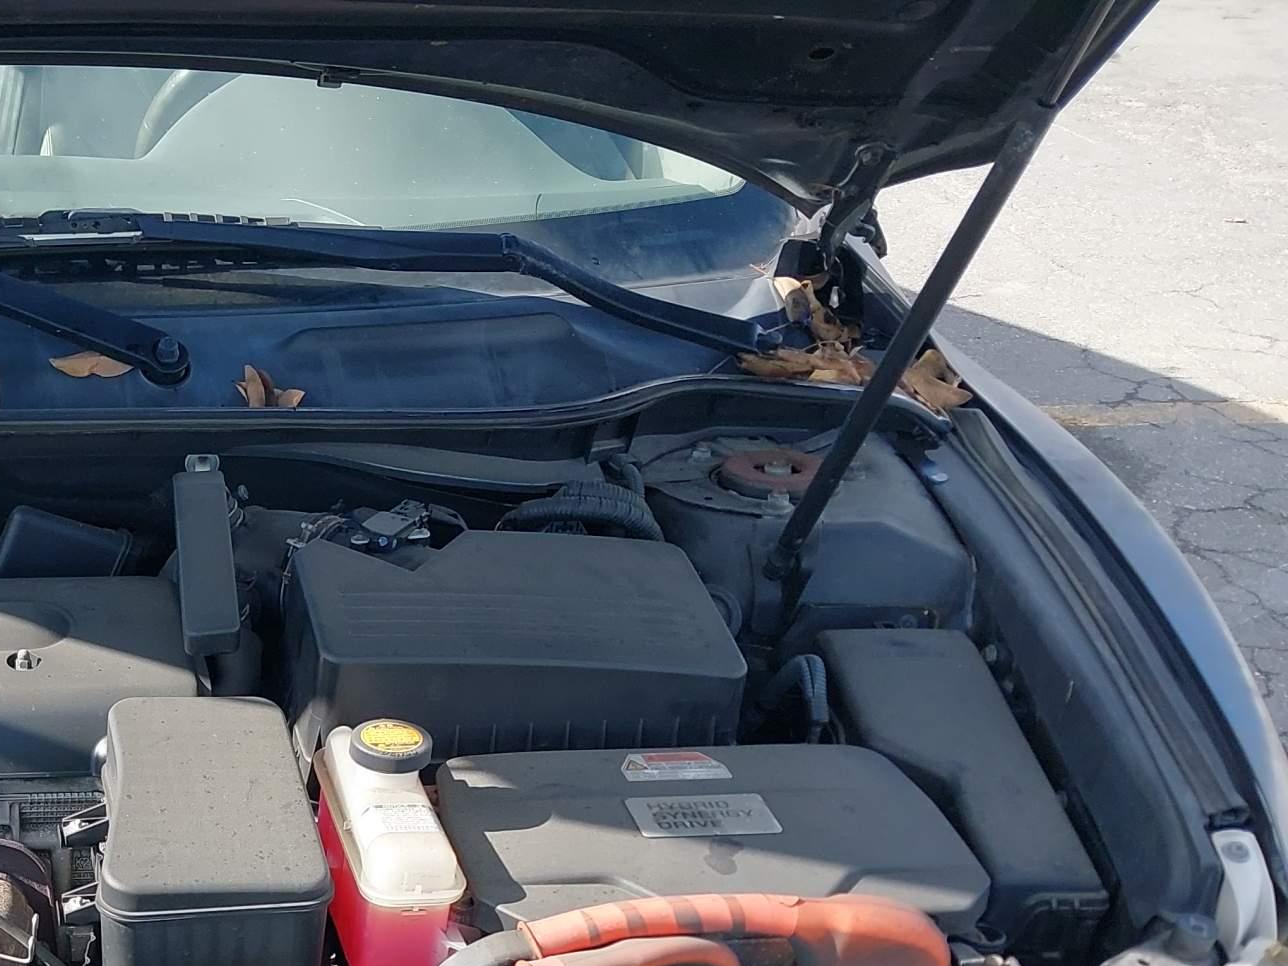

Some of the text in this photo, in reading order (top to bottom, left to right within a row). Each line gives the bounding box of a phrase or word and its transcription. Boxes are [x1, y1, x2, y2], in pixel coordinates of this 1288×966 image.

[647, 800, 729, 811] HYBRID
[652, 809, 753, 820] SYNERGY
[657, 820, 722, 831] DRIVE
